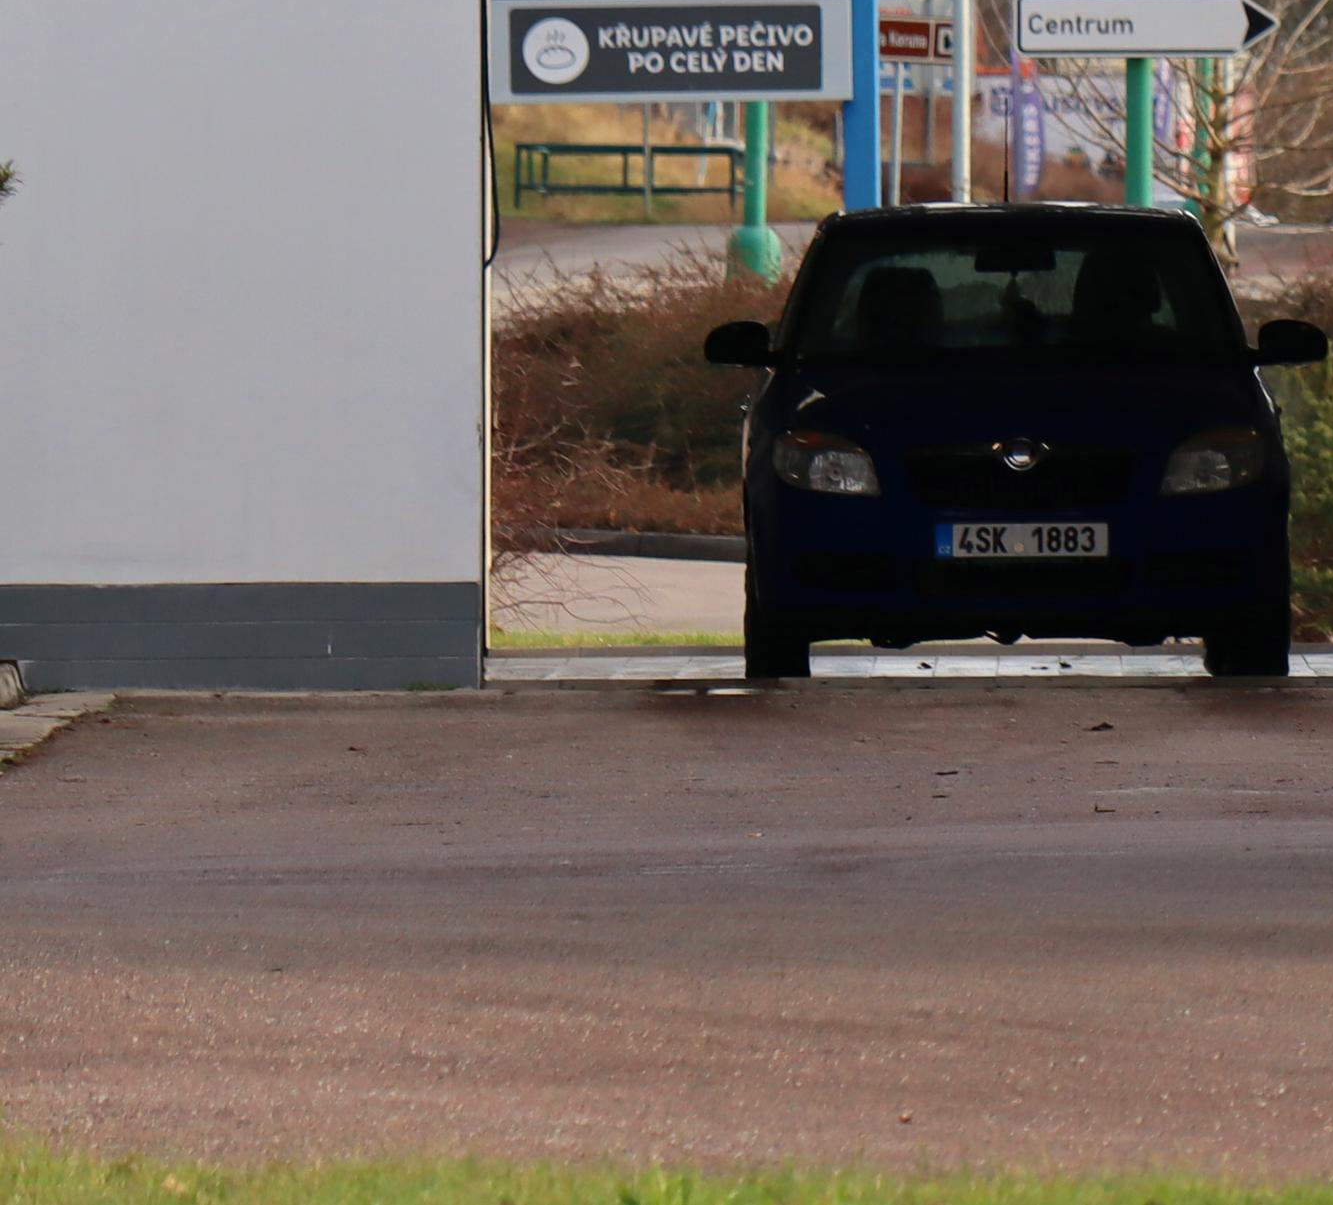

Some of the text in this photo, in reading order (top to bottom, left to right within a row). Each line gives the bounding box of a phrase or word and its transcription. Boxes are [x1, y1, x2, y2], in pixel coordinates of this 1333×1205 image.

[598, 21, 813, 48] KŘUPAVÉ PEČIVO
[1028, 14, 1134, 35] Centrum
[628, 47, 785, 74] PO CELÝ DEN
[938, 545, 951, 554] CZ
[958, 526, 1096, 554] 4SK 1883
